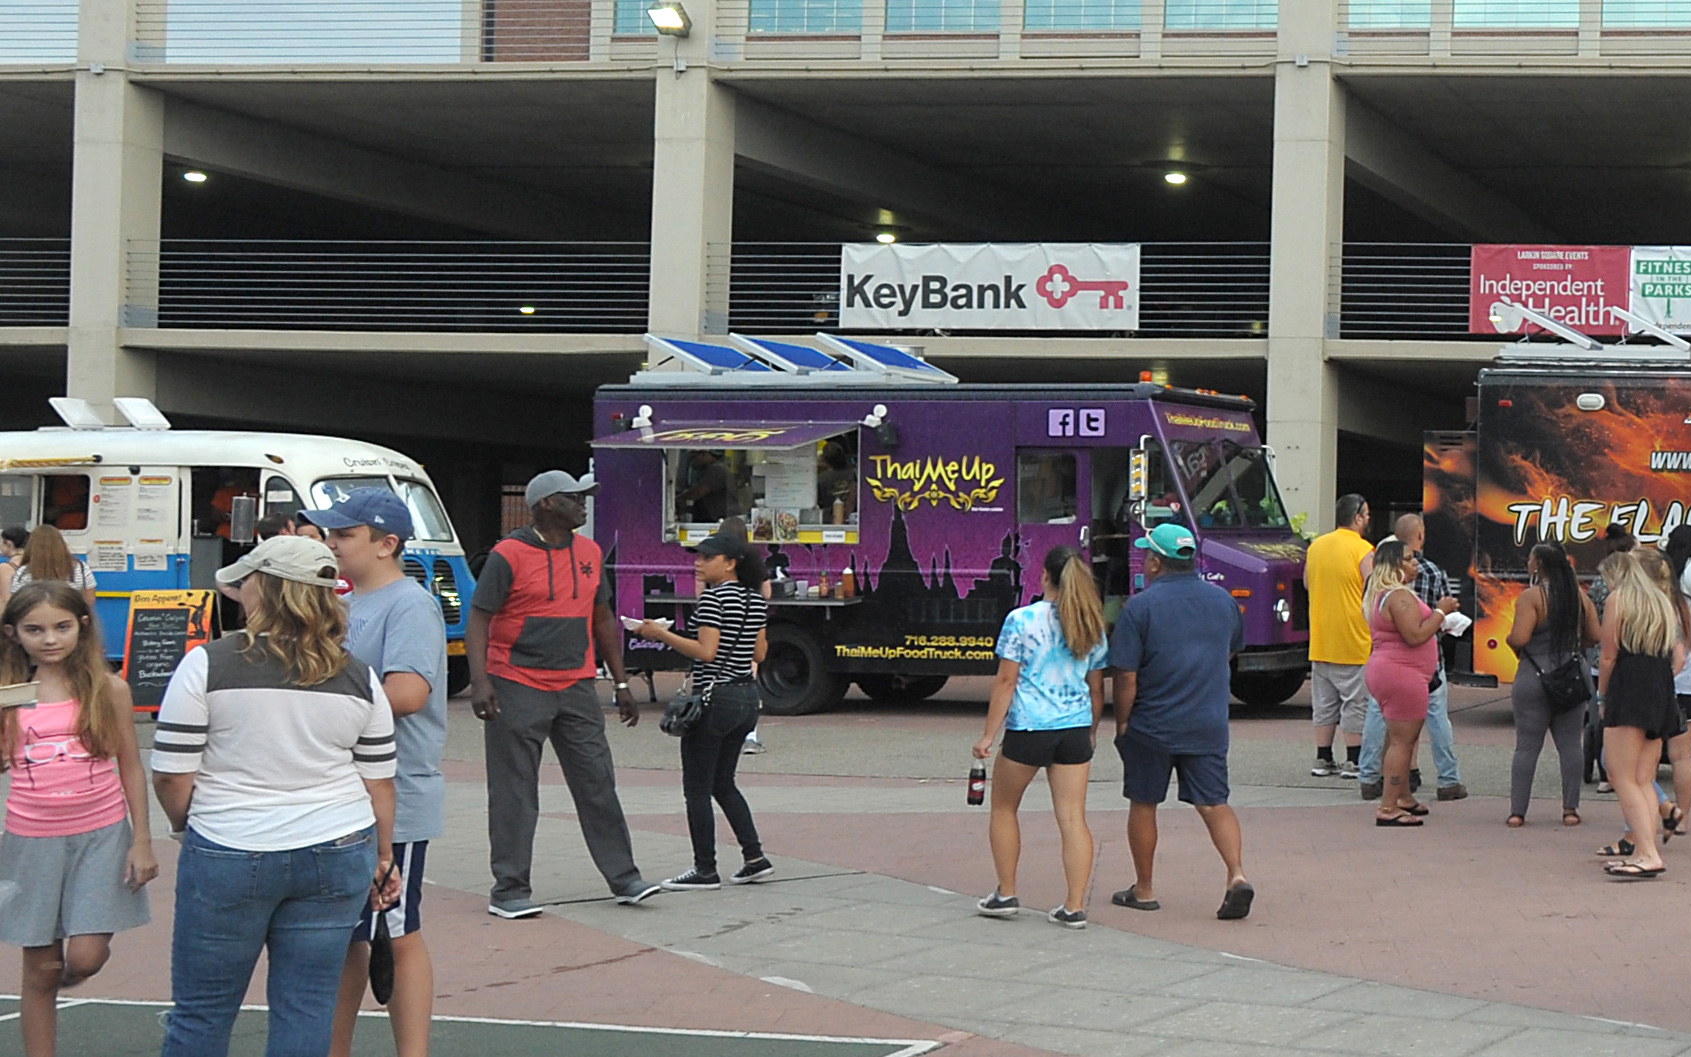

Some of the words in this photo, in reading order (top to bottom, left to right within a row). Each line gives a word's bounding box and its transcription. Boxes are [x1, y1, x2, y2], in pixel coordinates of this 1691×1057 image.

[1518, 251, 1540, 260] LARKIN
[1541, 251, 1565, 260] SQUARE
[1565, 251, 1589, 260] EVENTS
[846, 274, 1027, 317] KeyBank
[1480, 273, 1605, 301] Independent
[1528, 297, 1615, 326] Health
[1507, 496, 1605, 545] THE
[834, 645, 994, 660] ThaiMeUpFoodTruck.com
